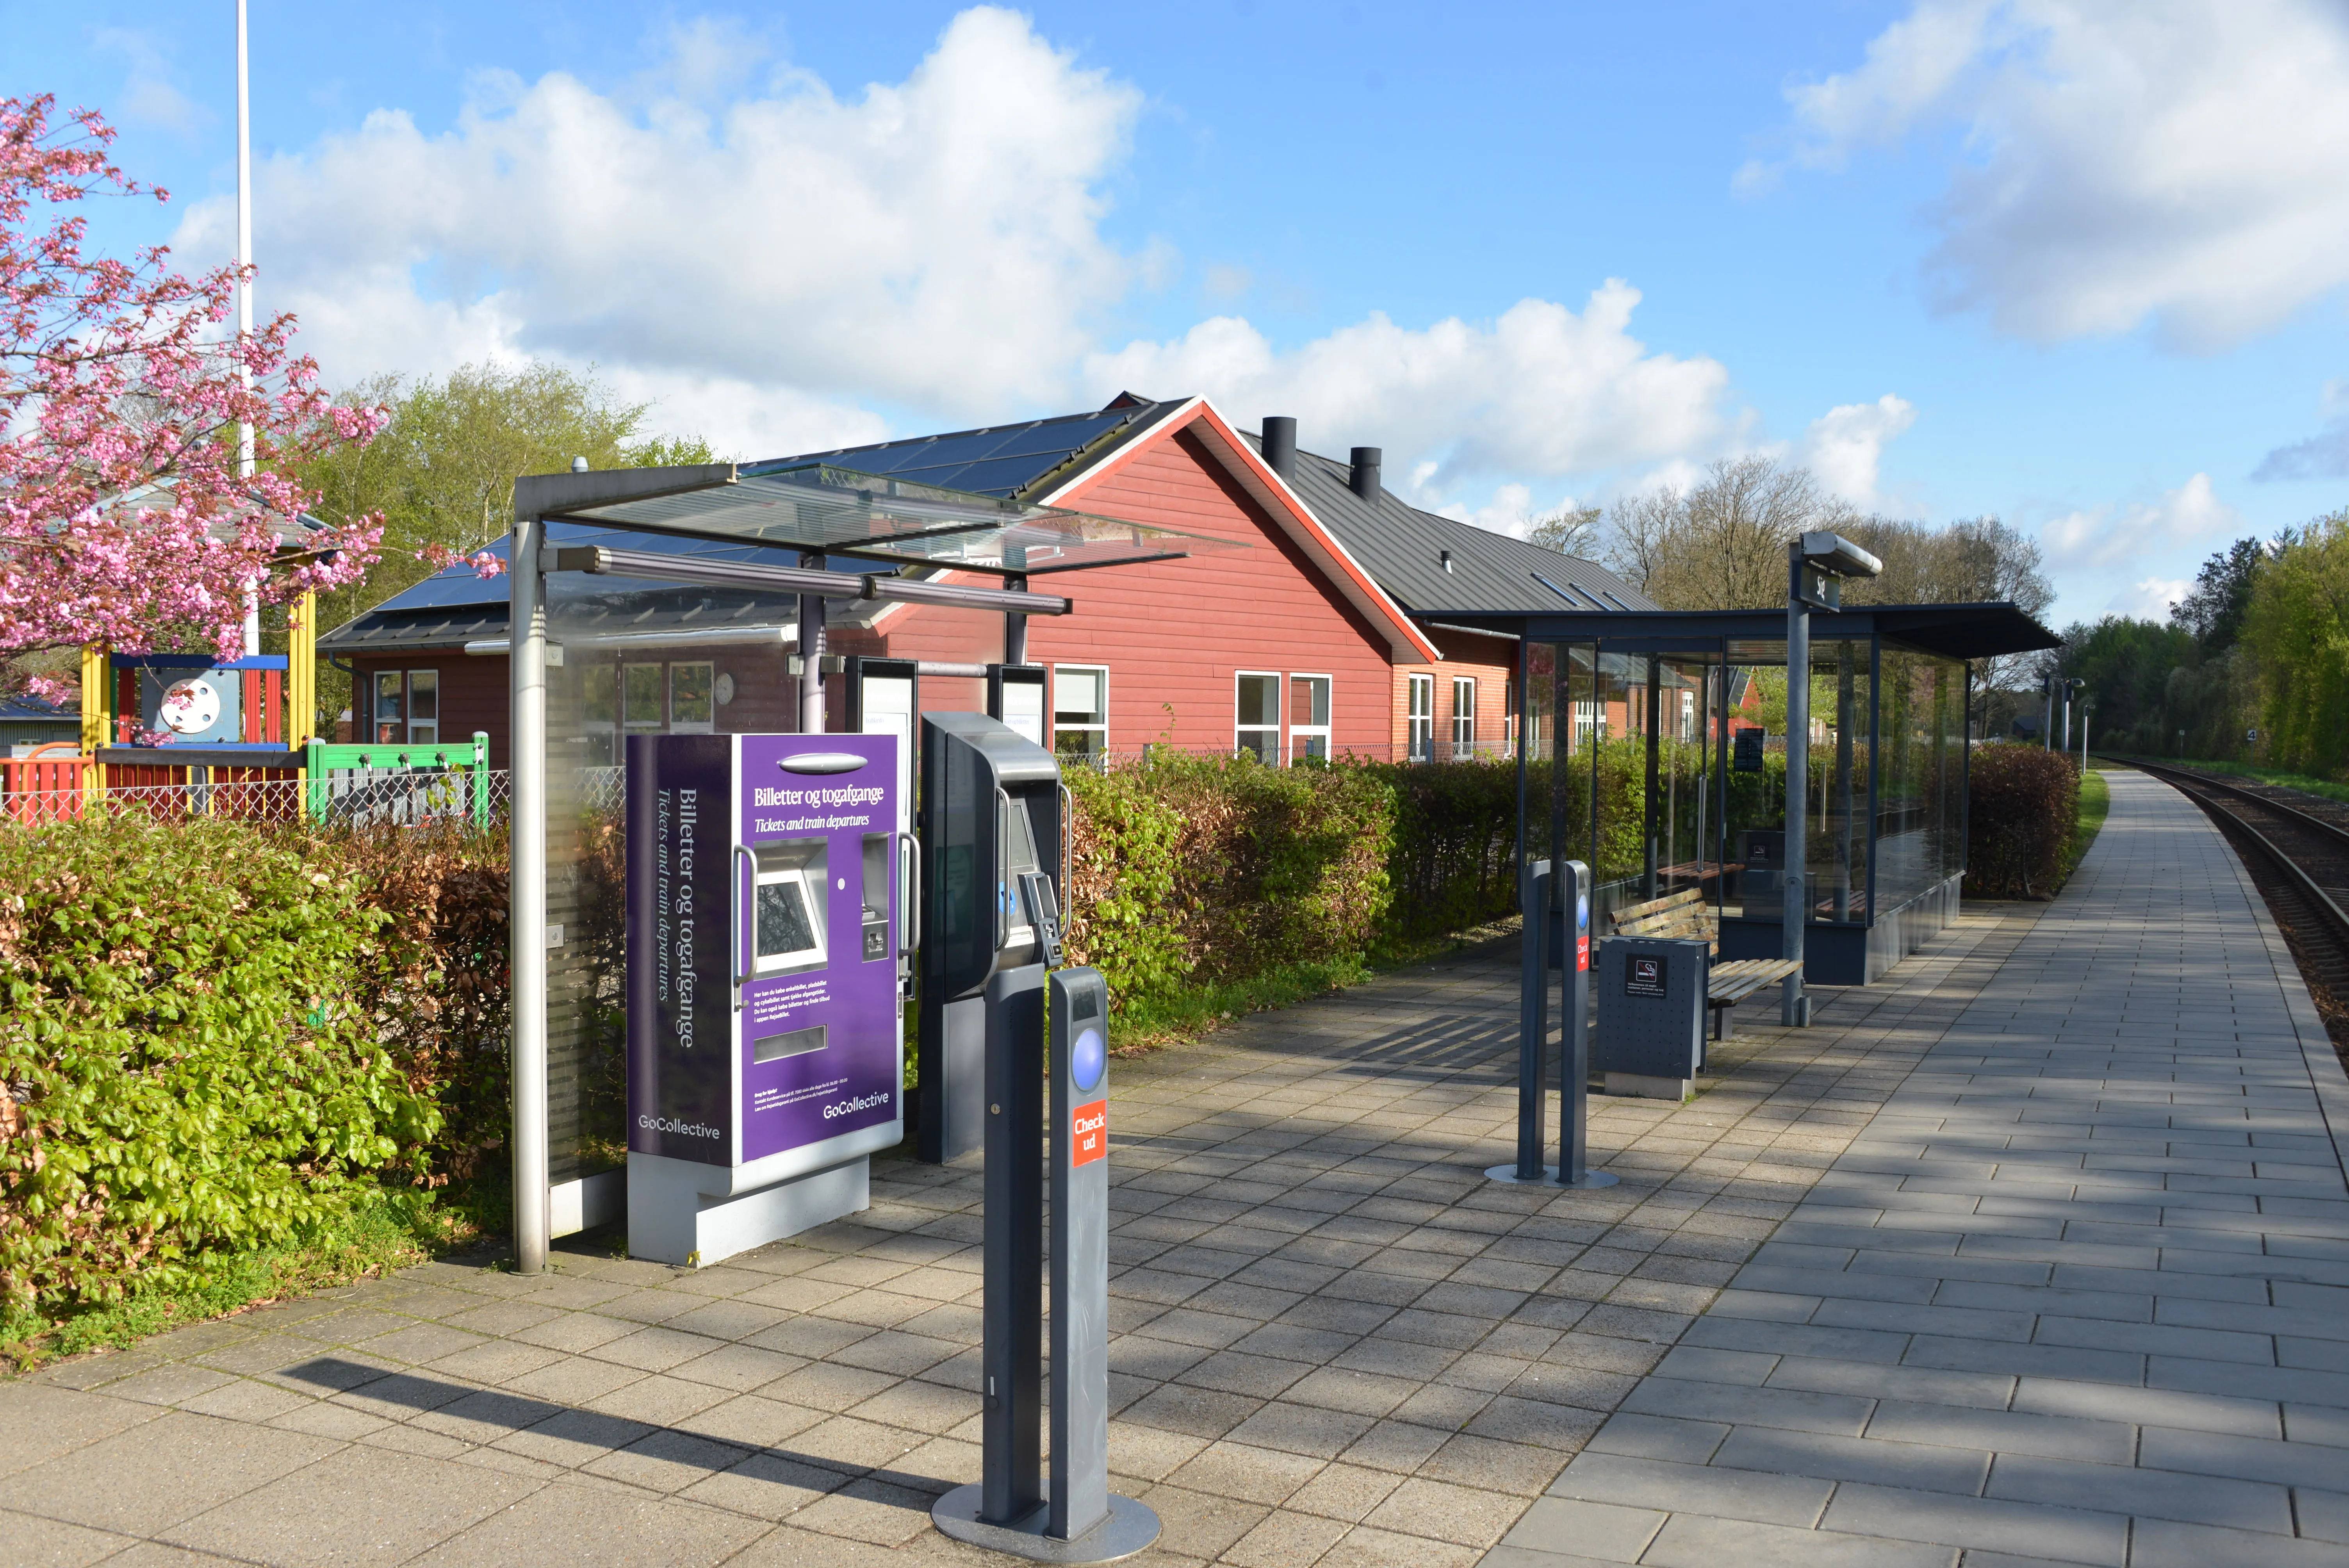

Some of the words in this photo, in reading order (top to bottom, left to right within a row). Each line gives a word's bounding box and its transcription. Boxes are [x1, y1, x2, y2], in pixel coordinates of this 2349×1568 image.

[1817, 575, 1825, 601] Sig
[2248, 731, 2255, 739] 4
[755, 787, 804, 806] Billetter
[805, 790, 820, 808] og
[822, 784, 884, 807] togafgange
[659, 788, 670, 841] Tickets
[755, 818, 785, 832] Tickets
[786, 816, 804, 830] and
[804, 816, 825, 829] train
[826, 814, 870, 830] departures
[680, 788, 697, 880] Billetter
[659, 844, 670, 876] and
[659, 877, 670, 915] train
[676, 885, 693, 914] og
[1578, 943, 1588, 953] Check
[1580, 954, 1585, 964] ud
[657, 918, 670, 1002] departures
[676, 918, 697, 1048] togafgange
[808, 980, 827, 989] pladsbillet
[760, 997, 780, 1006] cykelbillet
[802, 989, 826, 998] afgangstider.
[769, 1012, 790, 1020] RejseBillet.
[766, 1093, 786, 1101] Kundeservice
[766, 1099, 789, 1109] Rejsetidsgaranti
[794, 1086, 838, 1101] GoCollective.dk/rejsetidsgaranti
[823, 1091, 889, 1120] GoCollective
[638, 1114, 720, 1140] GoCollective
[1075, 1112, 1104, 1135] Check
[1083, 1133, 1096, 1151] ud
